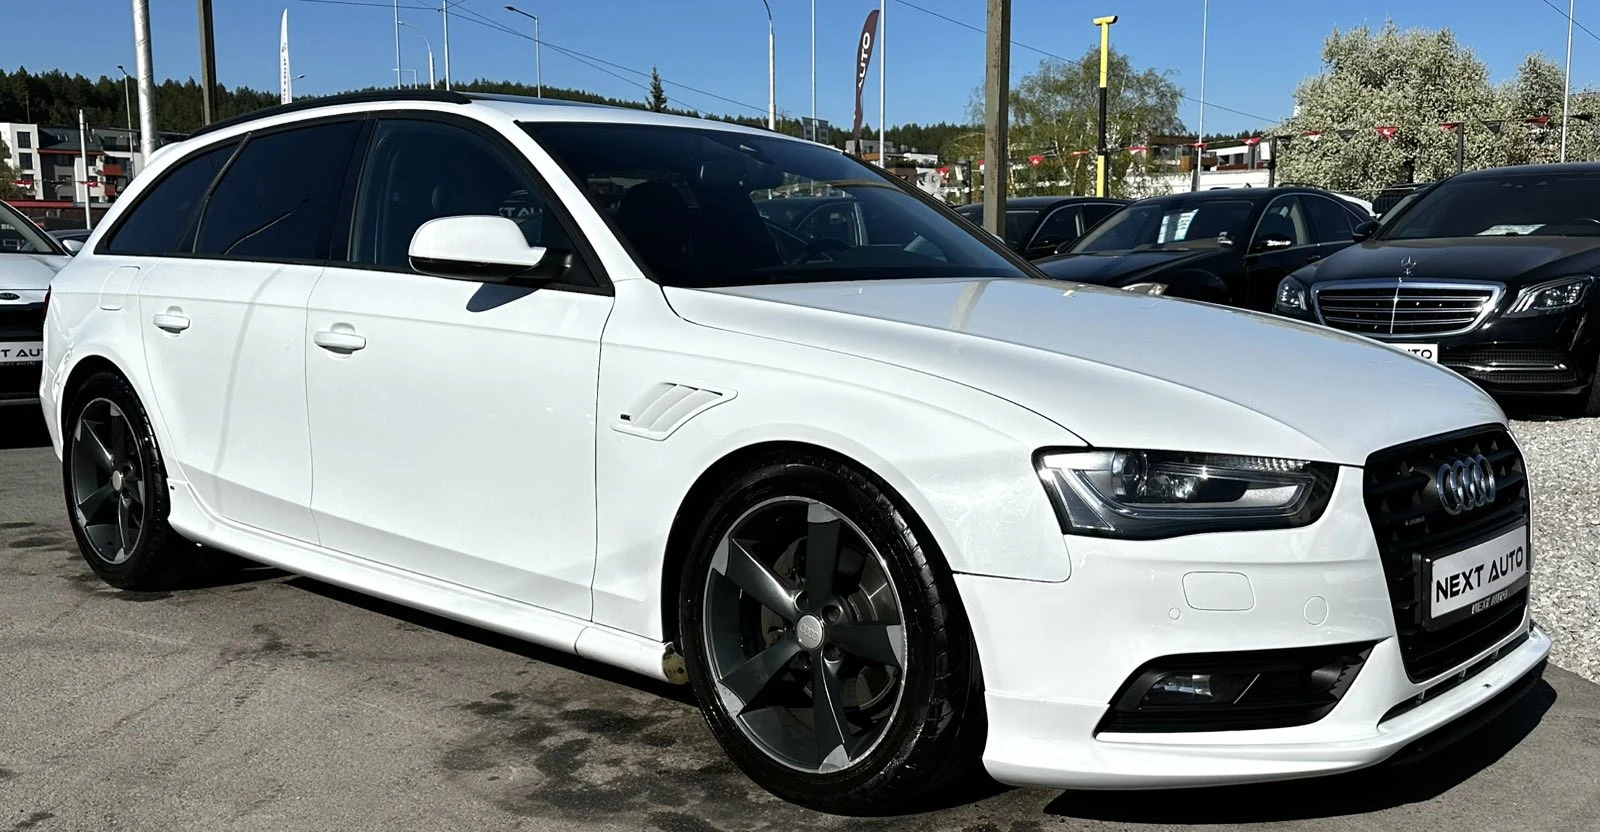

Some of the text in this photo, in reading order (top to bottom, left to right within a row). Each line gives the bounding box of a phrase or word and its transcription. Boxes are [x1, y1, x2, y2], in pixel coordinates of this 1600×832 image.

[16, 348, 43, 358] AU
[1408, 349, 1433, 359] TO
[1436, 546, 1523, 603] NEXT AUTO
